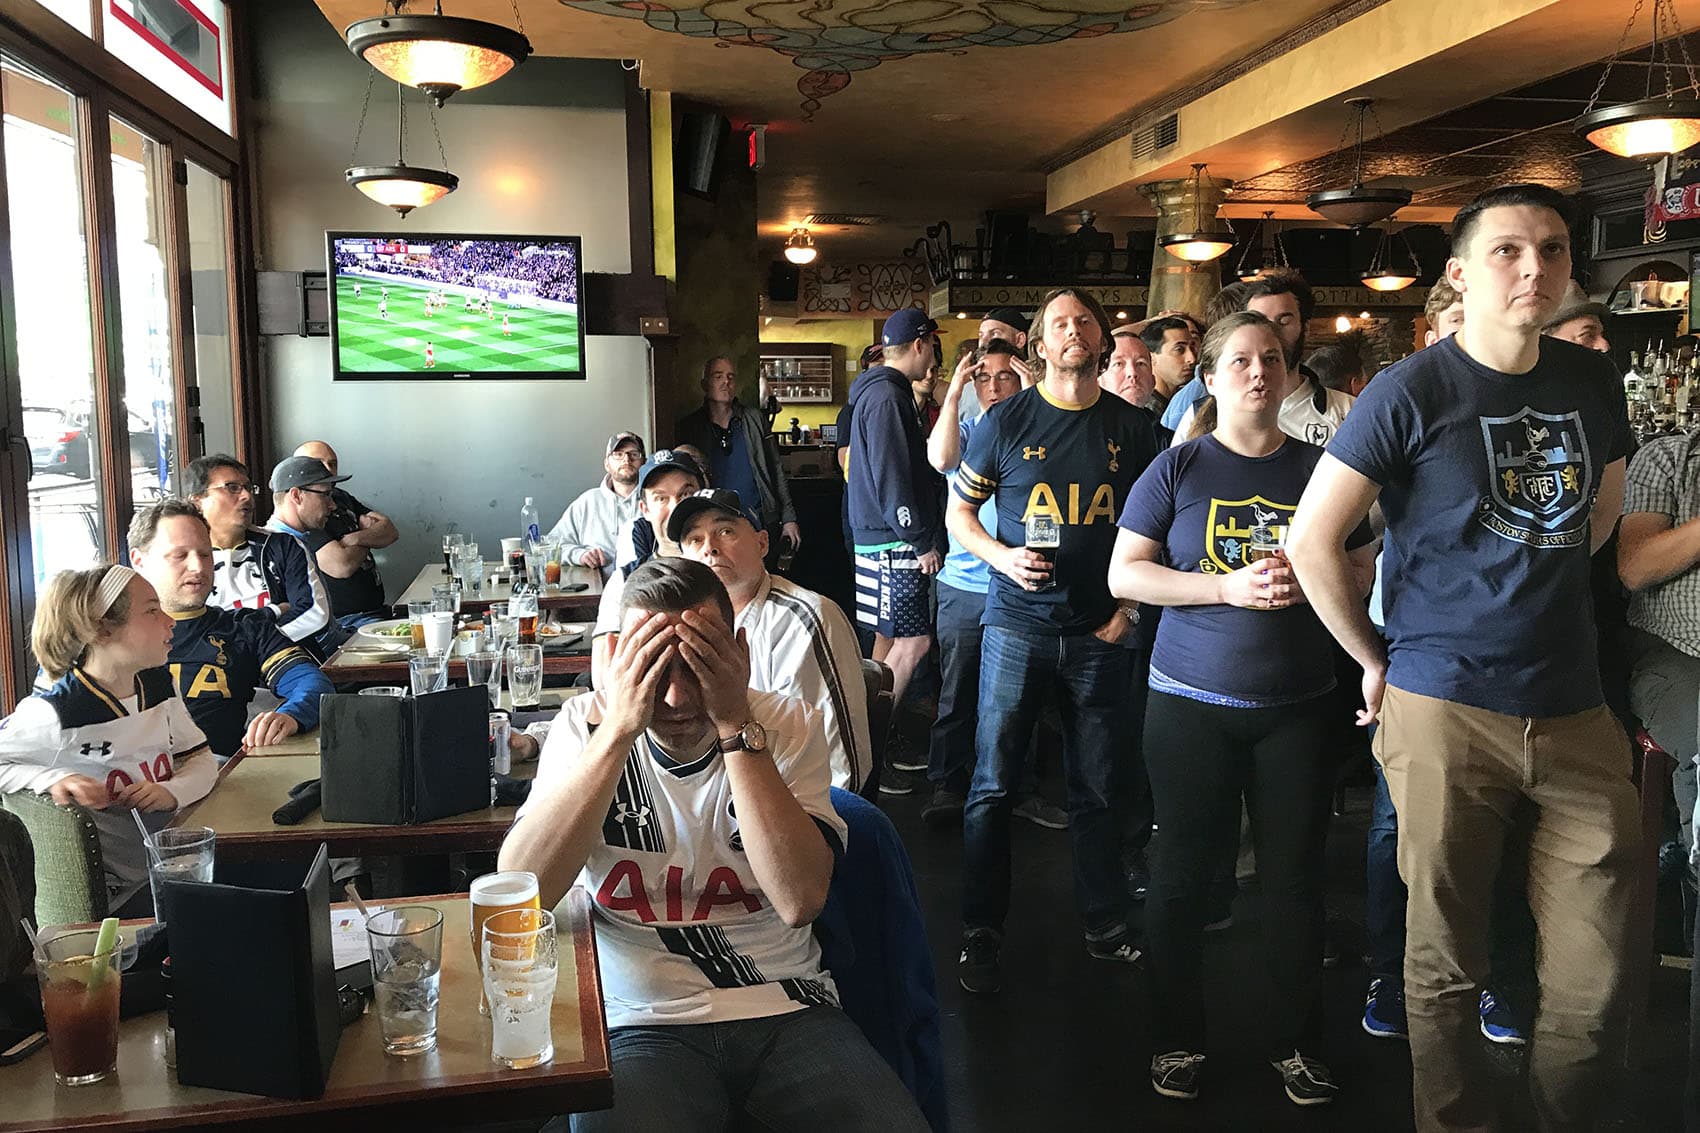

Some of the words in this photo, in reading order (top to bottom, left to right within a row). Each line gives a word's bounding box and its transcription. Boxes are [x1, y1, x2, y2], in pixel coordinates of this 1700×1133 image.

[1021, 483, 1115, 525] AIA
[1487, 517, 1521, 537] BOSTON
[878, 550, 891, 585] STAT
[879, 584, 891, 621] PENN
[169, 663, 232, 698] IA
[105, 753, 174, 801] AIA
[596, 859, 763, 923] AIA
